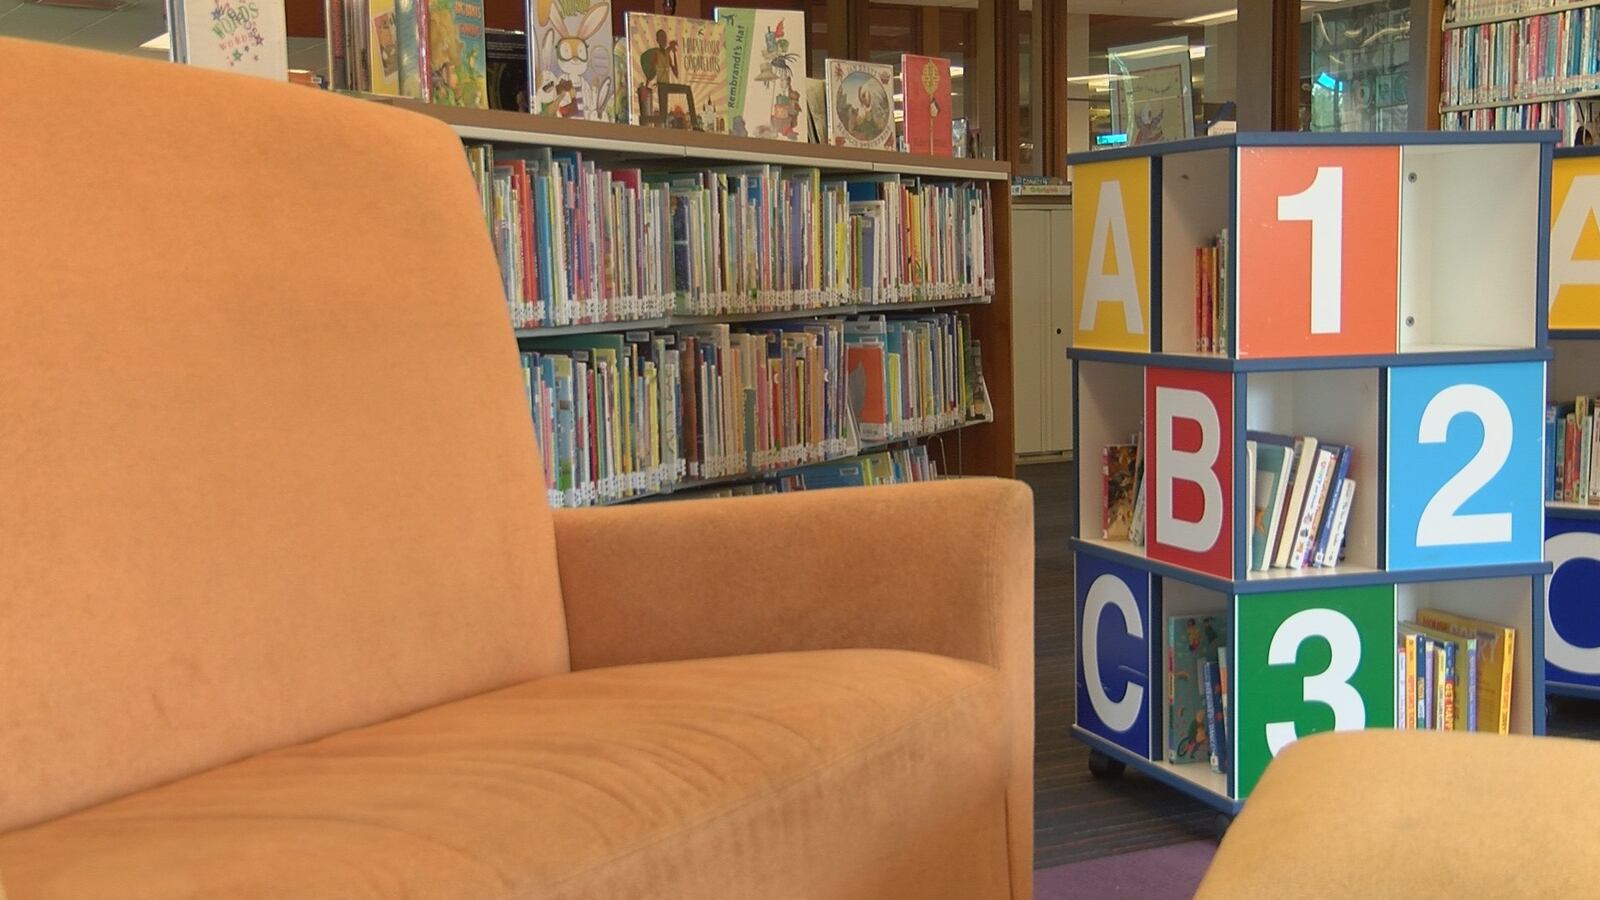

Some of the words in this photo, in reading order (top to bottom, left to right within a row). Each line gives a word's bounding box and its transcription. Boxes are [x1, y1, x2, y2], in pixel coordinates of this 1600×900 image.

[727, 45, 743, 108] Rembrandt's
[735, 25, 745, 42] Hat
[1079, 180, 1144, 335] A
[1277, 166, 1343, 335] 1
[1156, 386, 1224, 553] B
[1416, 384, 1514, 548] 2
[1081, 573, 1144, 733] C
[1265, 607, 1366, 759] 3
